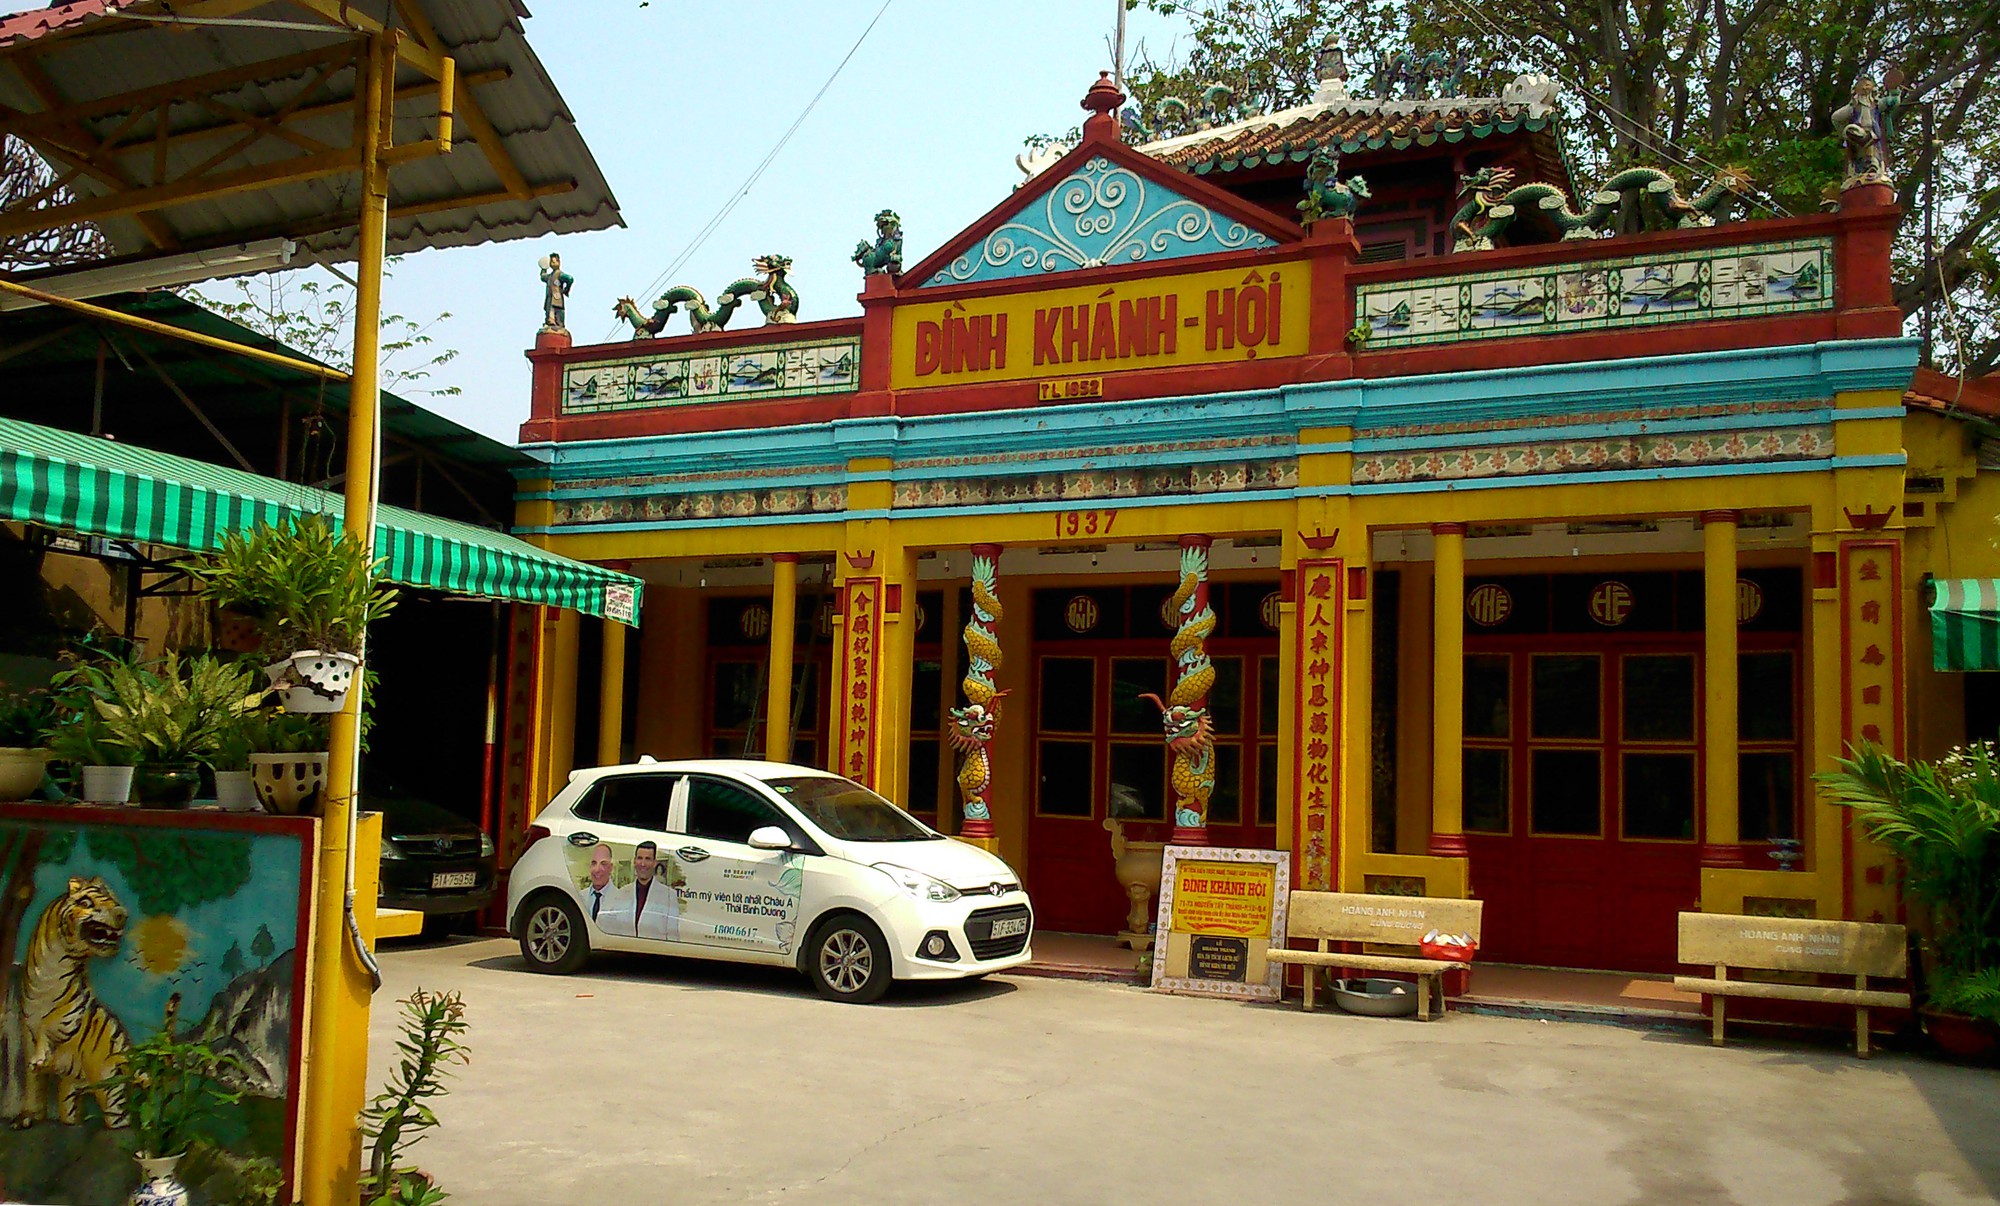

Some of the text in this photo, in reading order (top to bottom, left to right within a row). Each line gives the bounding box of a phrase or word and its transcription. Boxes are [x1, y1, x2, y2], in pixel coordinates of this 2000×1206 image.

[915, 300, 1008, 376] ĐÌNH
[1055, 510, 1118, 537] 1937
[1210, 877, 1246, 896] KHÁNH
[1248, 880, 1267, 899] HỘI
